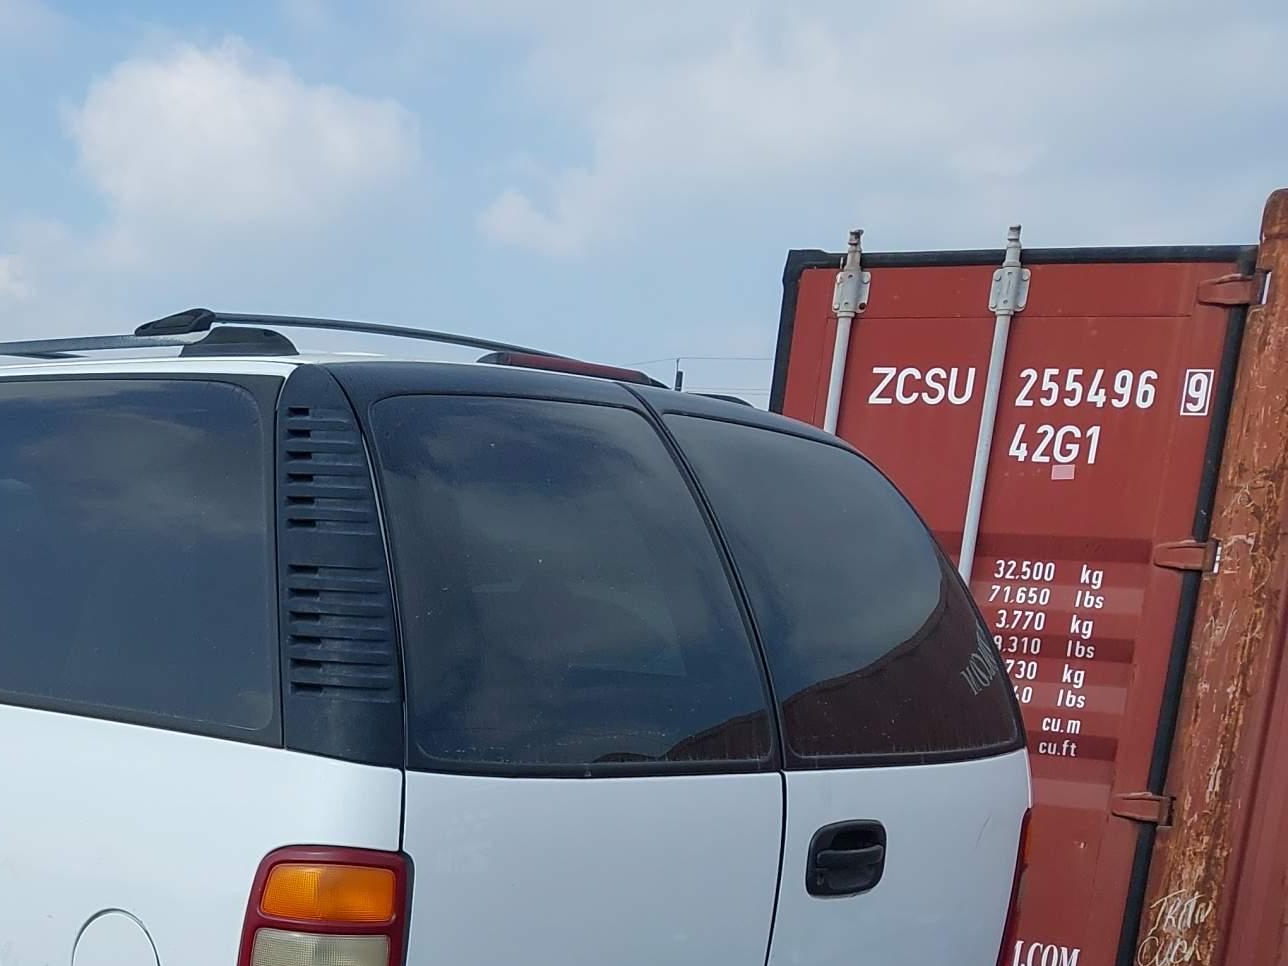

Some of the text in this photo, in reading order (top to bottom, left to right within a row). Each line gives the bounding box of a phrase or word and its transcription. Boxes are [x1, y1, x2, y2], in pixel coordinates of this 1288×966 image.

[868, 367, 1210, 413] ZCSU 255496 9
[1009, 424, 1101, 465] 42G1
[1080, 564, 1104, 589] kg
[1074, 590, 1105, 609] lbs
[1070, 614, 1094, 639] kg
[1067, 640, 1095, 659] lbs
[1062, 664, 1085, 688] kg
[1057, 689, 1086, 708] lbs
[1042, 716, 1081, 734] cu.m
[1038, 740, 1077, 757] cu.ft
